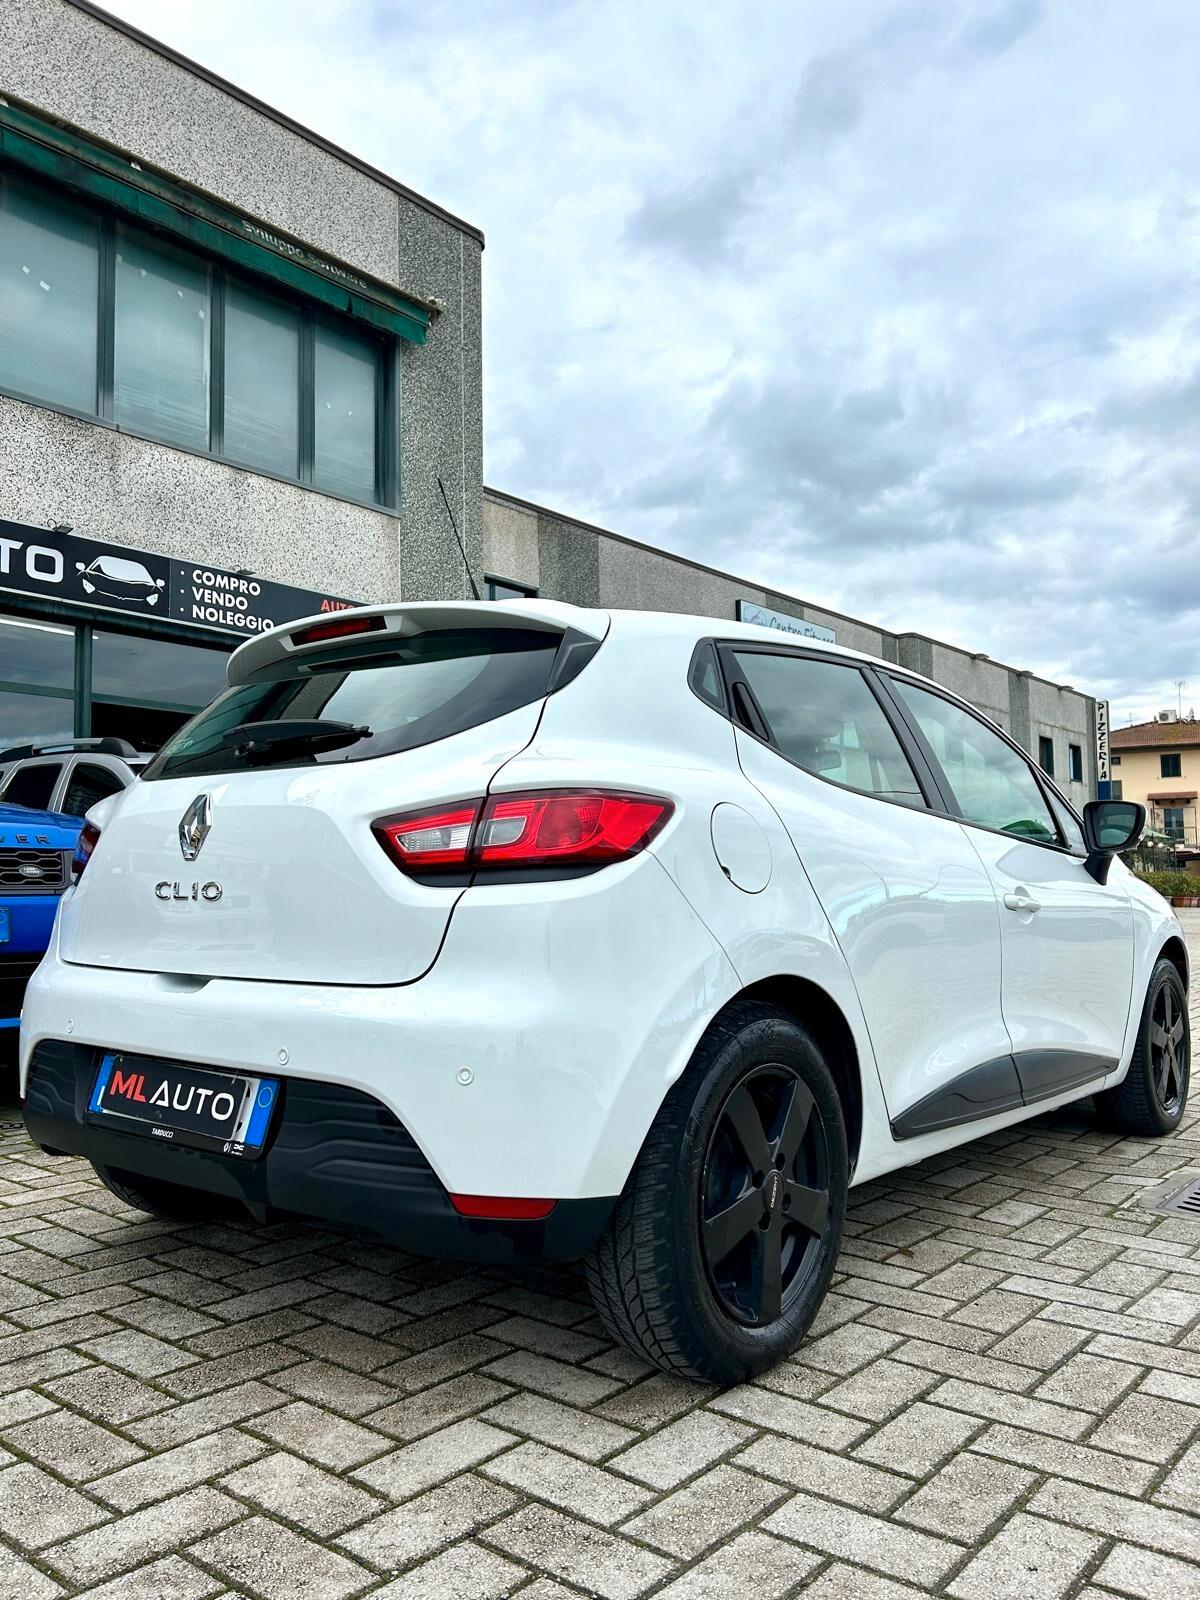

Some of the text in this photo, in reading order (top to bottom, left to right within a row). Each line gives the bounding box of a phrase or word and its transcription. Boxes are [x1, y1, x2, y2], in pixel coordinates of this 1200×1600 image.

[192, 569, 261, 597] COMPRO
[192, 587, 249, 611] VENDO
[192, 604, 275, 632] NOLEGGIO
[1097, 703, 1107, 779] PIZZERIA
[0, 834, 51, 845] ER
[154, 881, 223, 901] CLIO
